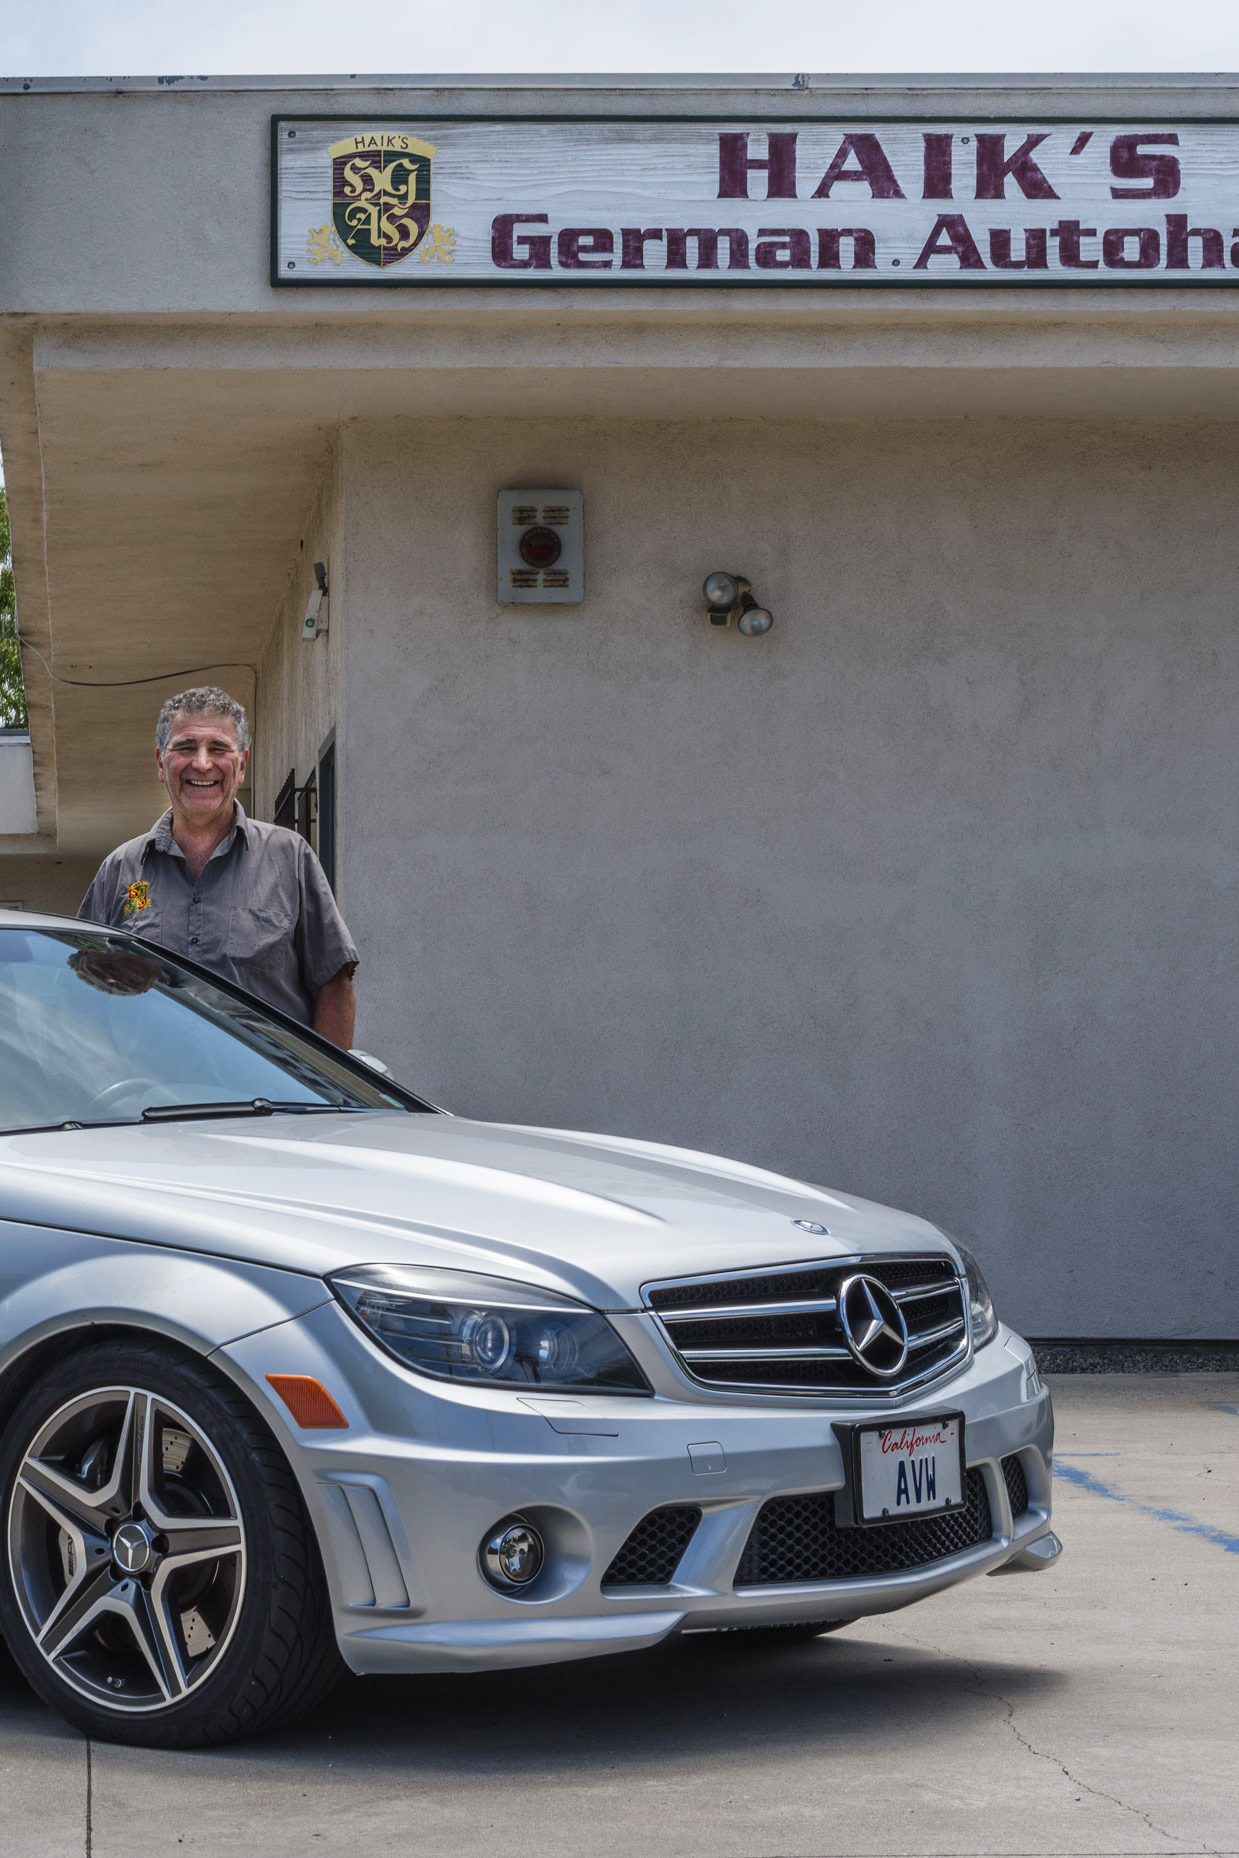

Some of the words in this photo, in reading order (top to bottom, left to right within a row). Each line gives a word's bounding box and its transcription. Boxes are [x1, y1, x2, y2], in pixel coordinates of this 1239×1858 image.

[354, 135, 410, 150] HAIK'S
[716, 131, 1181, 200] HAIK'S
[491, 213, 878, 269] German
[913, 213, 1239, 269] Autoh
[881, 1428, 947, 1457] California
[896, 1456, 937, 1506] AVW
